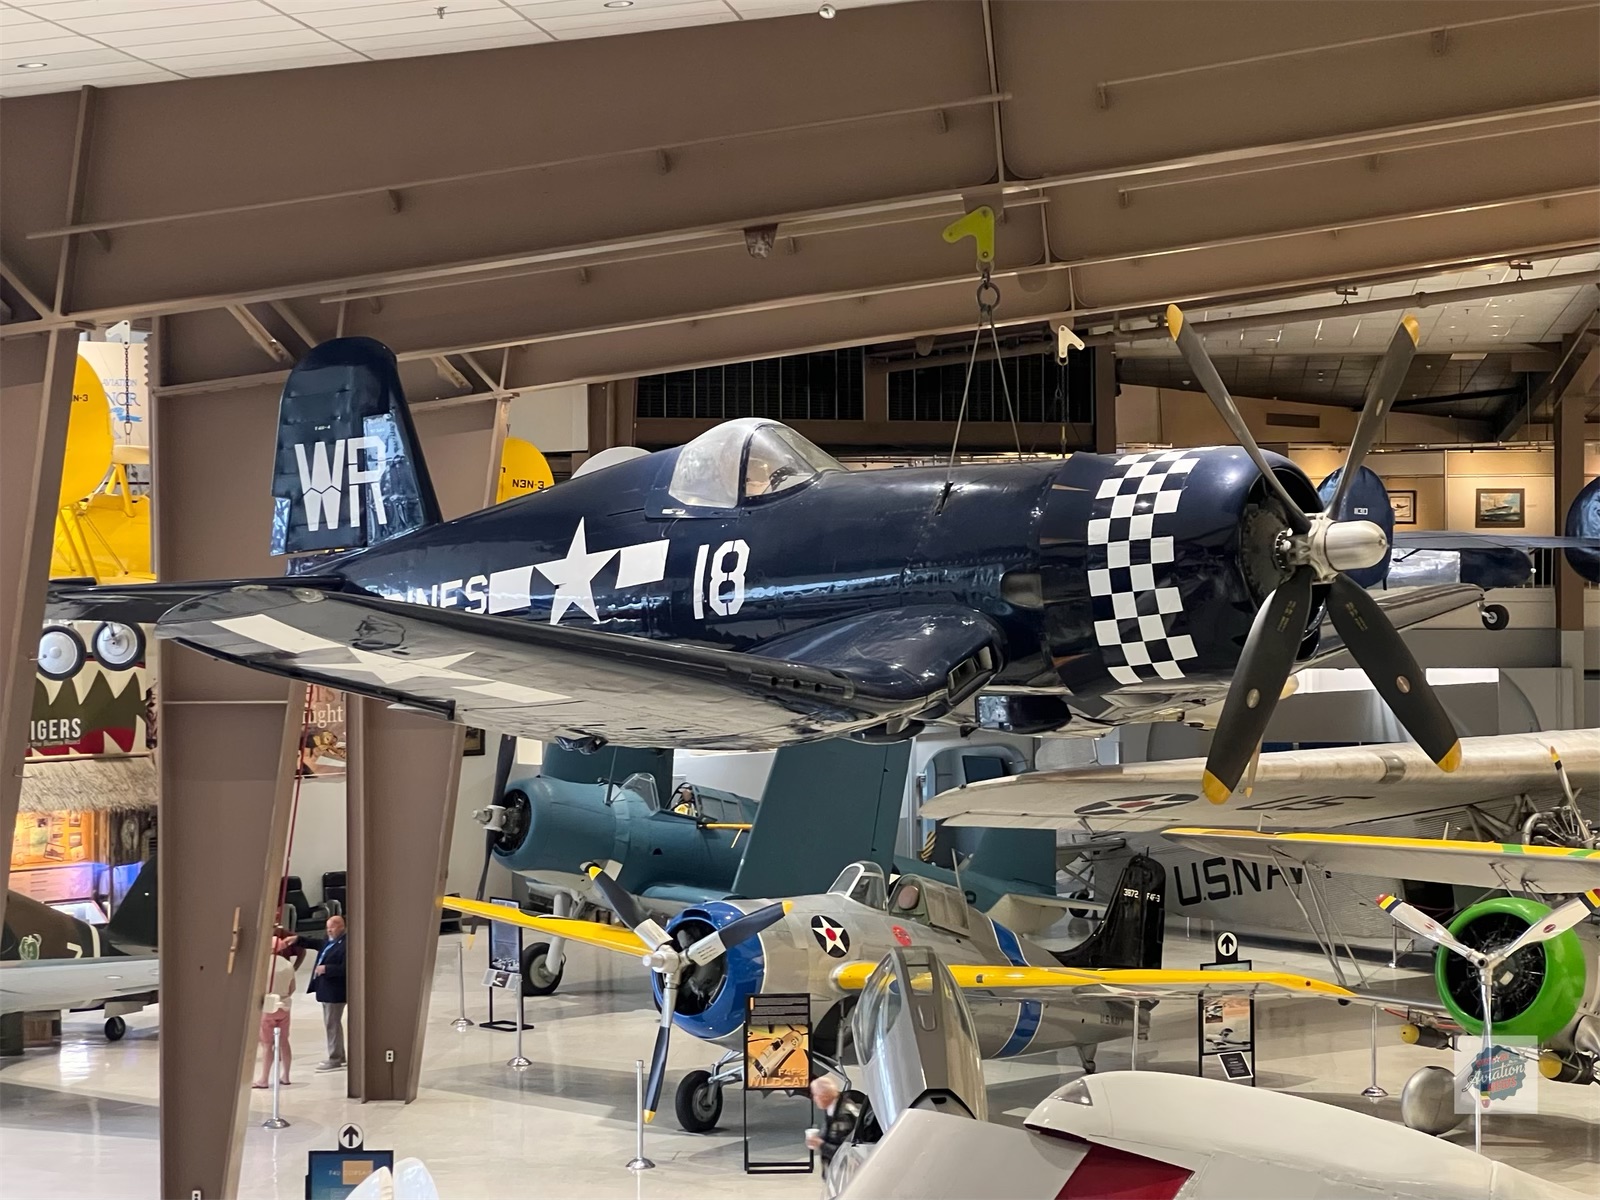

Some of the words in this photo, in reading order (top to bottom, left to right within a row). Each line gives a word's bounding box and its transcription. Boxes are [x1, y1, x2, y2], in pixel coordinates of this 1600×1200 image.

[73, 394, 89, 402] N-3
[294, 435, 388, 532] WR
[512, 479, 545, 490] N3N-3
[693, 539, 751, 620] 18
[30, 717, 81, 741] IGERS
[750, 1076, 807, 1087] WILDCAT
